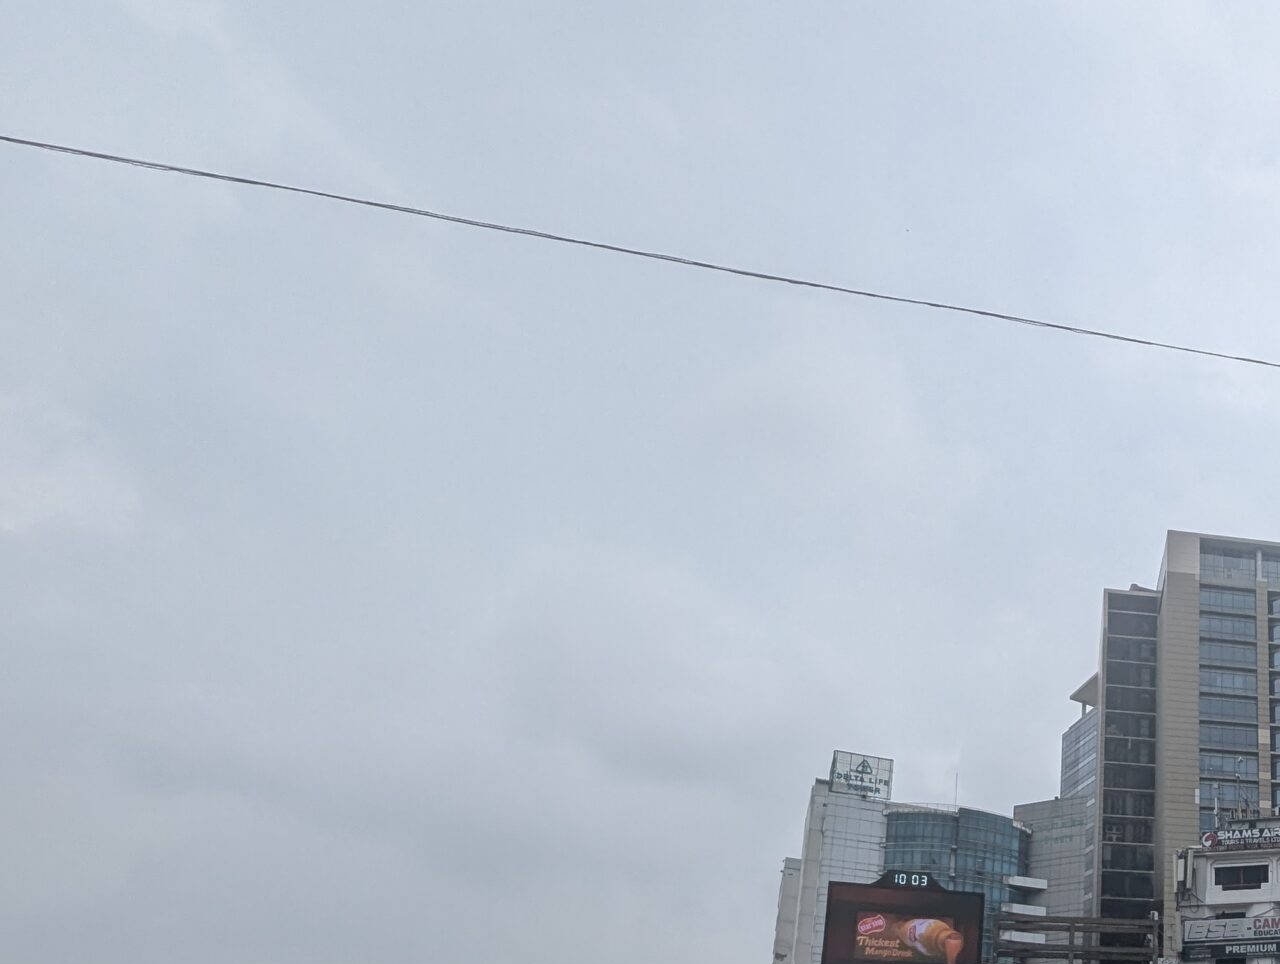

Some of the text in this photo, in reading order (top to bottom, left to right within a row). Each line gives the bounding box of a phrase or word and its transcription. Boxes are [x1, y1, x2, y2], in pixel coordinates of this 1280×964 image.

[1217, 828, 1260, 840] SHAMS
[857, 935, 900, 948] Thickest
[865, 946, 891, 958] Mango
[1225, 943, 1277, 954] PREMIUM
